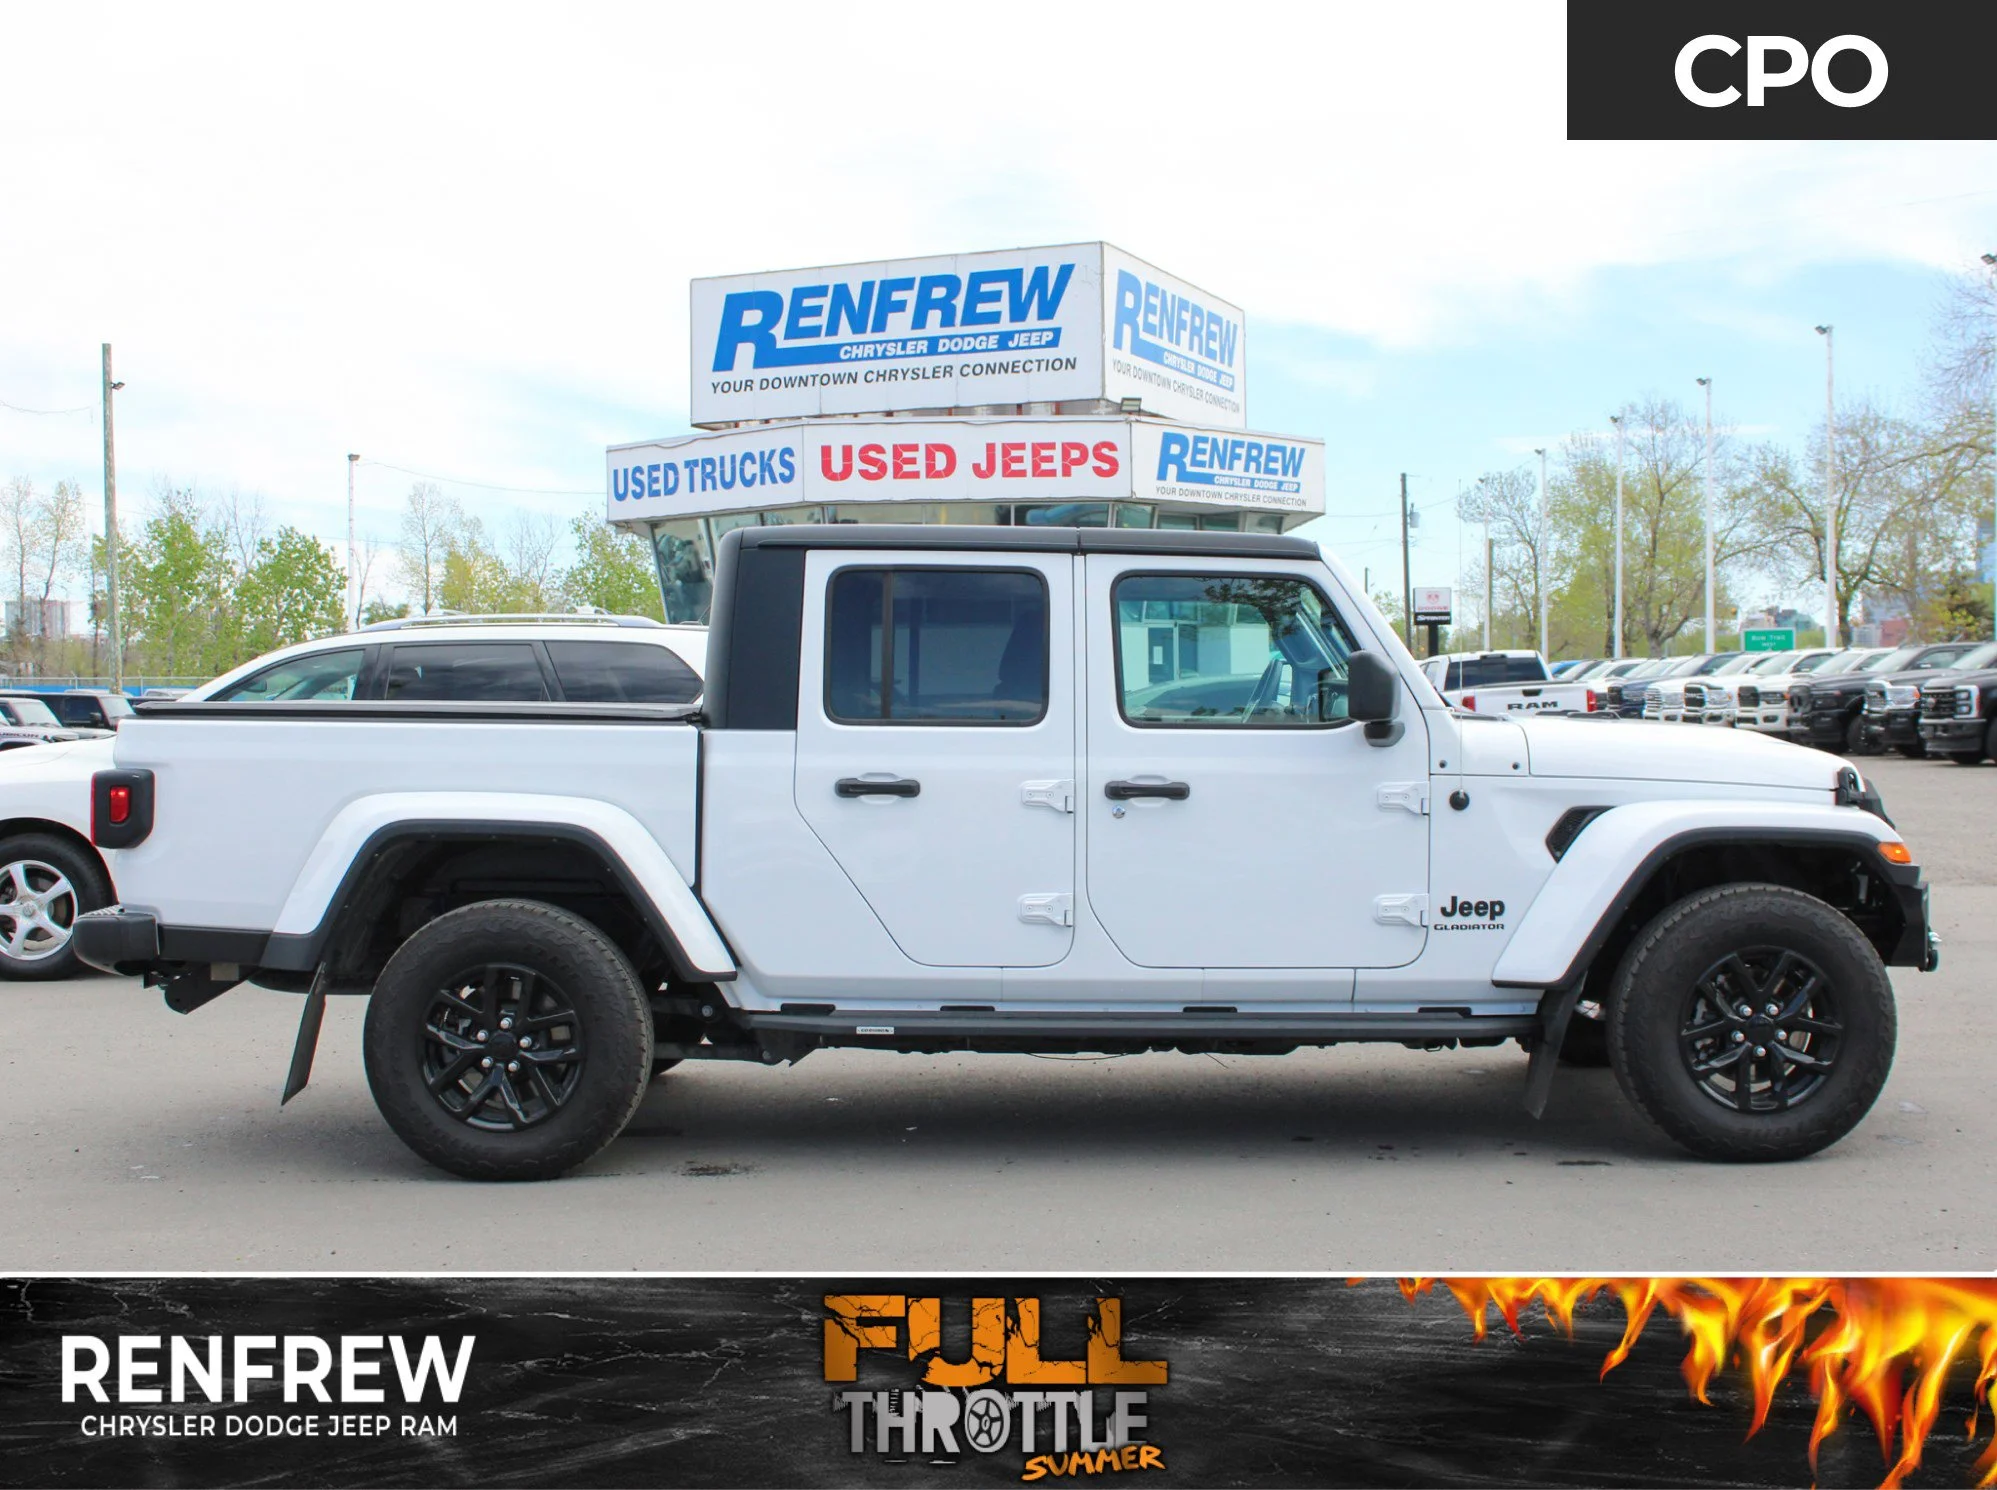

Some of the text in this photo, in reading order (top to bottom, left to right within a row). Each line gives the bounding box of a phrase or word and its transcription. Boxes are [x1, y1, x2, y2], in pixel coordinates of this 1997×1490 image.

[712, 263, 1076, 372] RENFREW
[1113, 268, 1238, 369] RENFREW
[839, 331, 1054, 360] CHRYSLER DODGE JEEP
[711, 357, 1077, 394] YOUR DOWNTOWN CHRYSLER CONNECTION
[1112, 358, 1240, 414] YOUR DOWNTOWN CHRYSLER CONNECTION
[613, 446, 796, 502] USED TRUCKS
[820, 440, 1120, 482] USED JEEPS
[1156, 431, 1306, 481] RENFREW
[1155, 486, 1307, 507] YOUR DOWNTOWN CHRYSLER CONNECTION
[1213, 475, 1299, 492] CHRYSLER DODGE JEEP
[1507, 701, 1558, 710] RAM
[1440, 895, 1505, 921] Jeep
[1433, 923, 1505, 931] GLADIATOR
